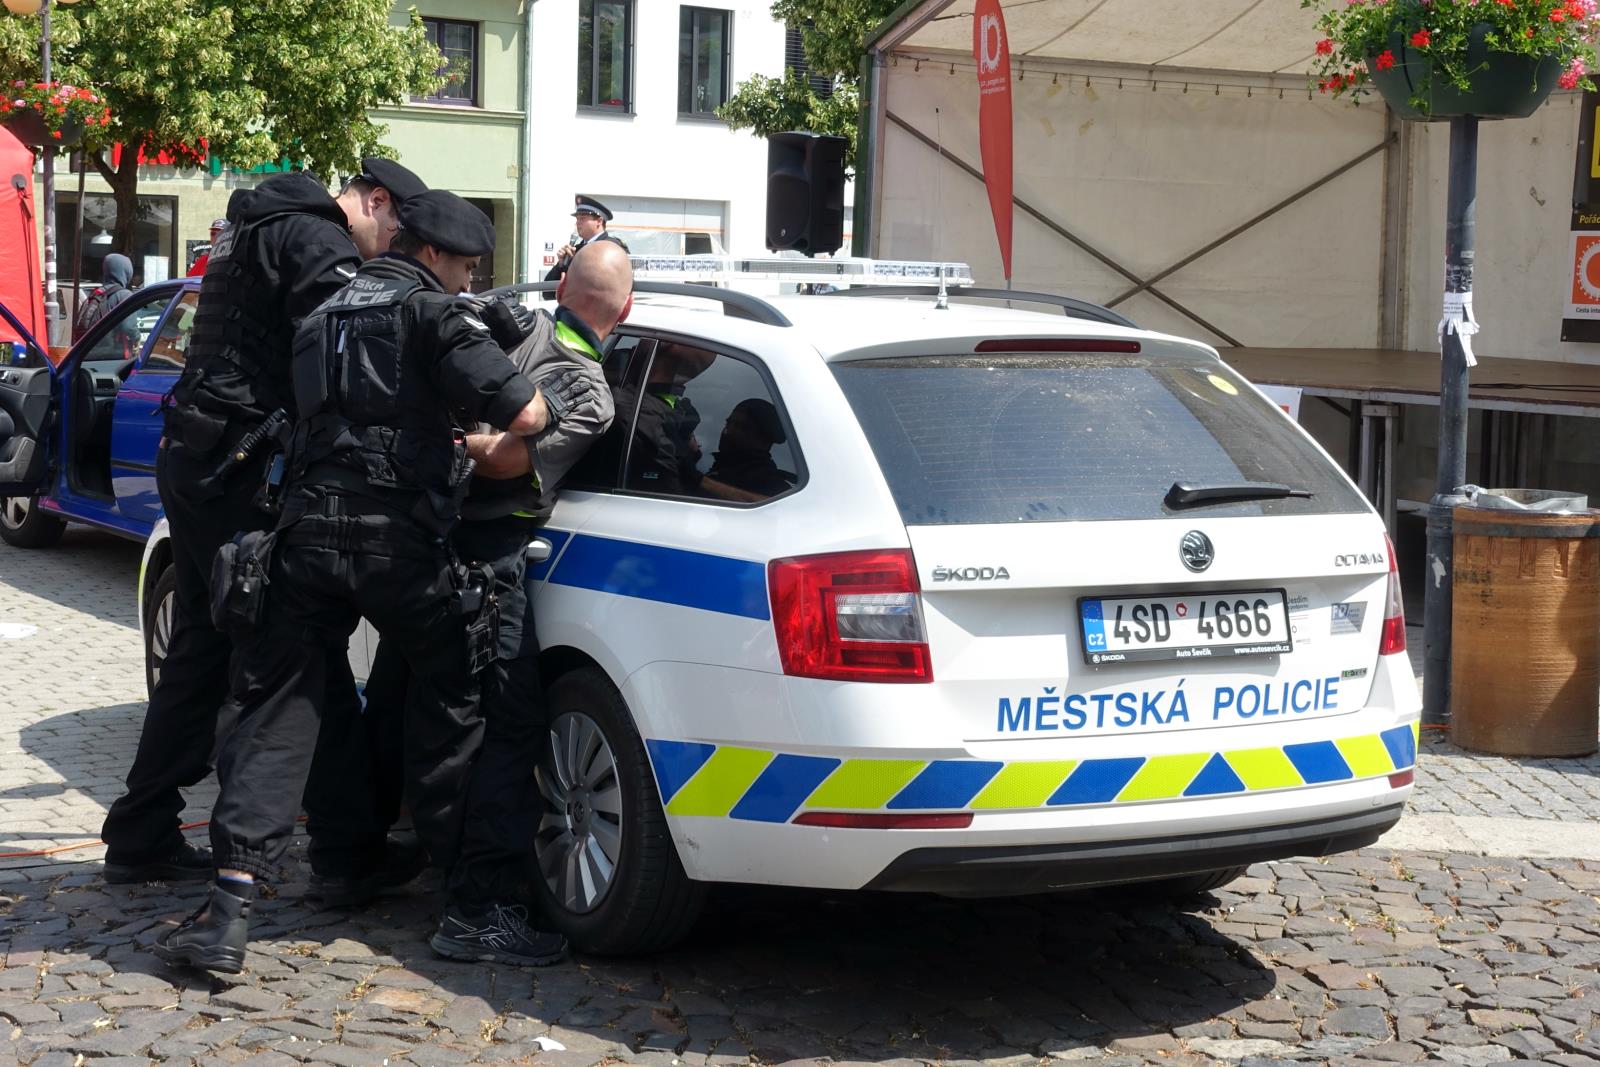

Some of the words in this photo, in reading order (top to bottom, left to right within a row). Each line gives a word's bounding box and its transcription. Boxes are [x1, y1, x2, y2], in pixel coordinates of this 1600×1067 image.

[1335, 553, 1383, 567] OCTAVIA
[932, 565, 1010, 582] ŠKODA
[1114, 603, 1171, 644] 4SD
[1198, 599, 1271, 639] 4666
[1088, 633, 1104, 646] CZ
[1192, 648, 1212, 656] Ševčík
[1234, 644, 1290, 654] www.autosevcik.cz
[997, 678, 1190, 732] MĚSTSKÁ
[1213, 677, 1340, 720] POLICIE
